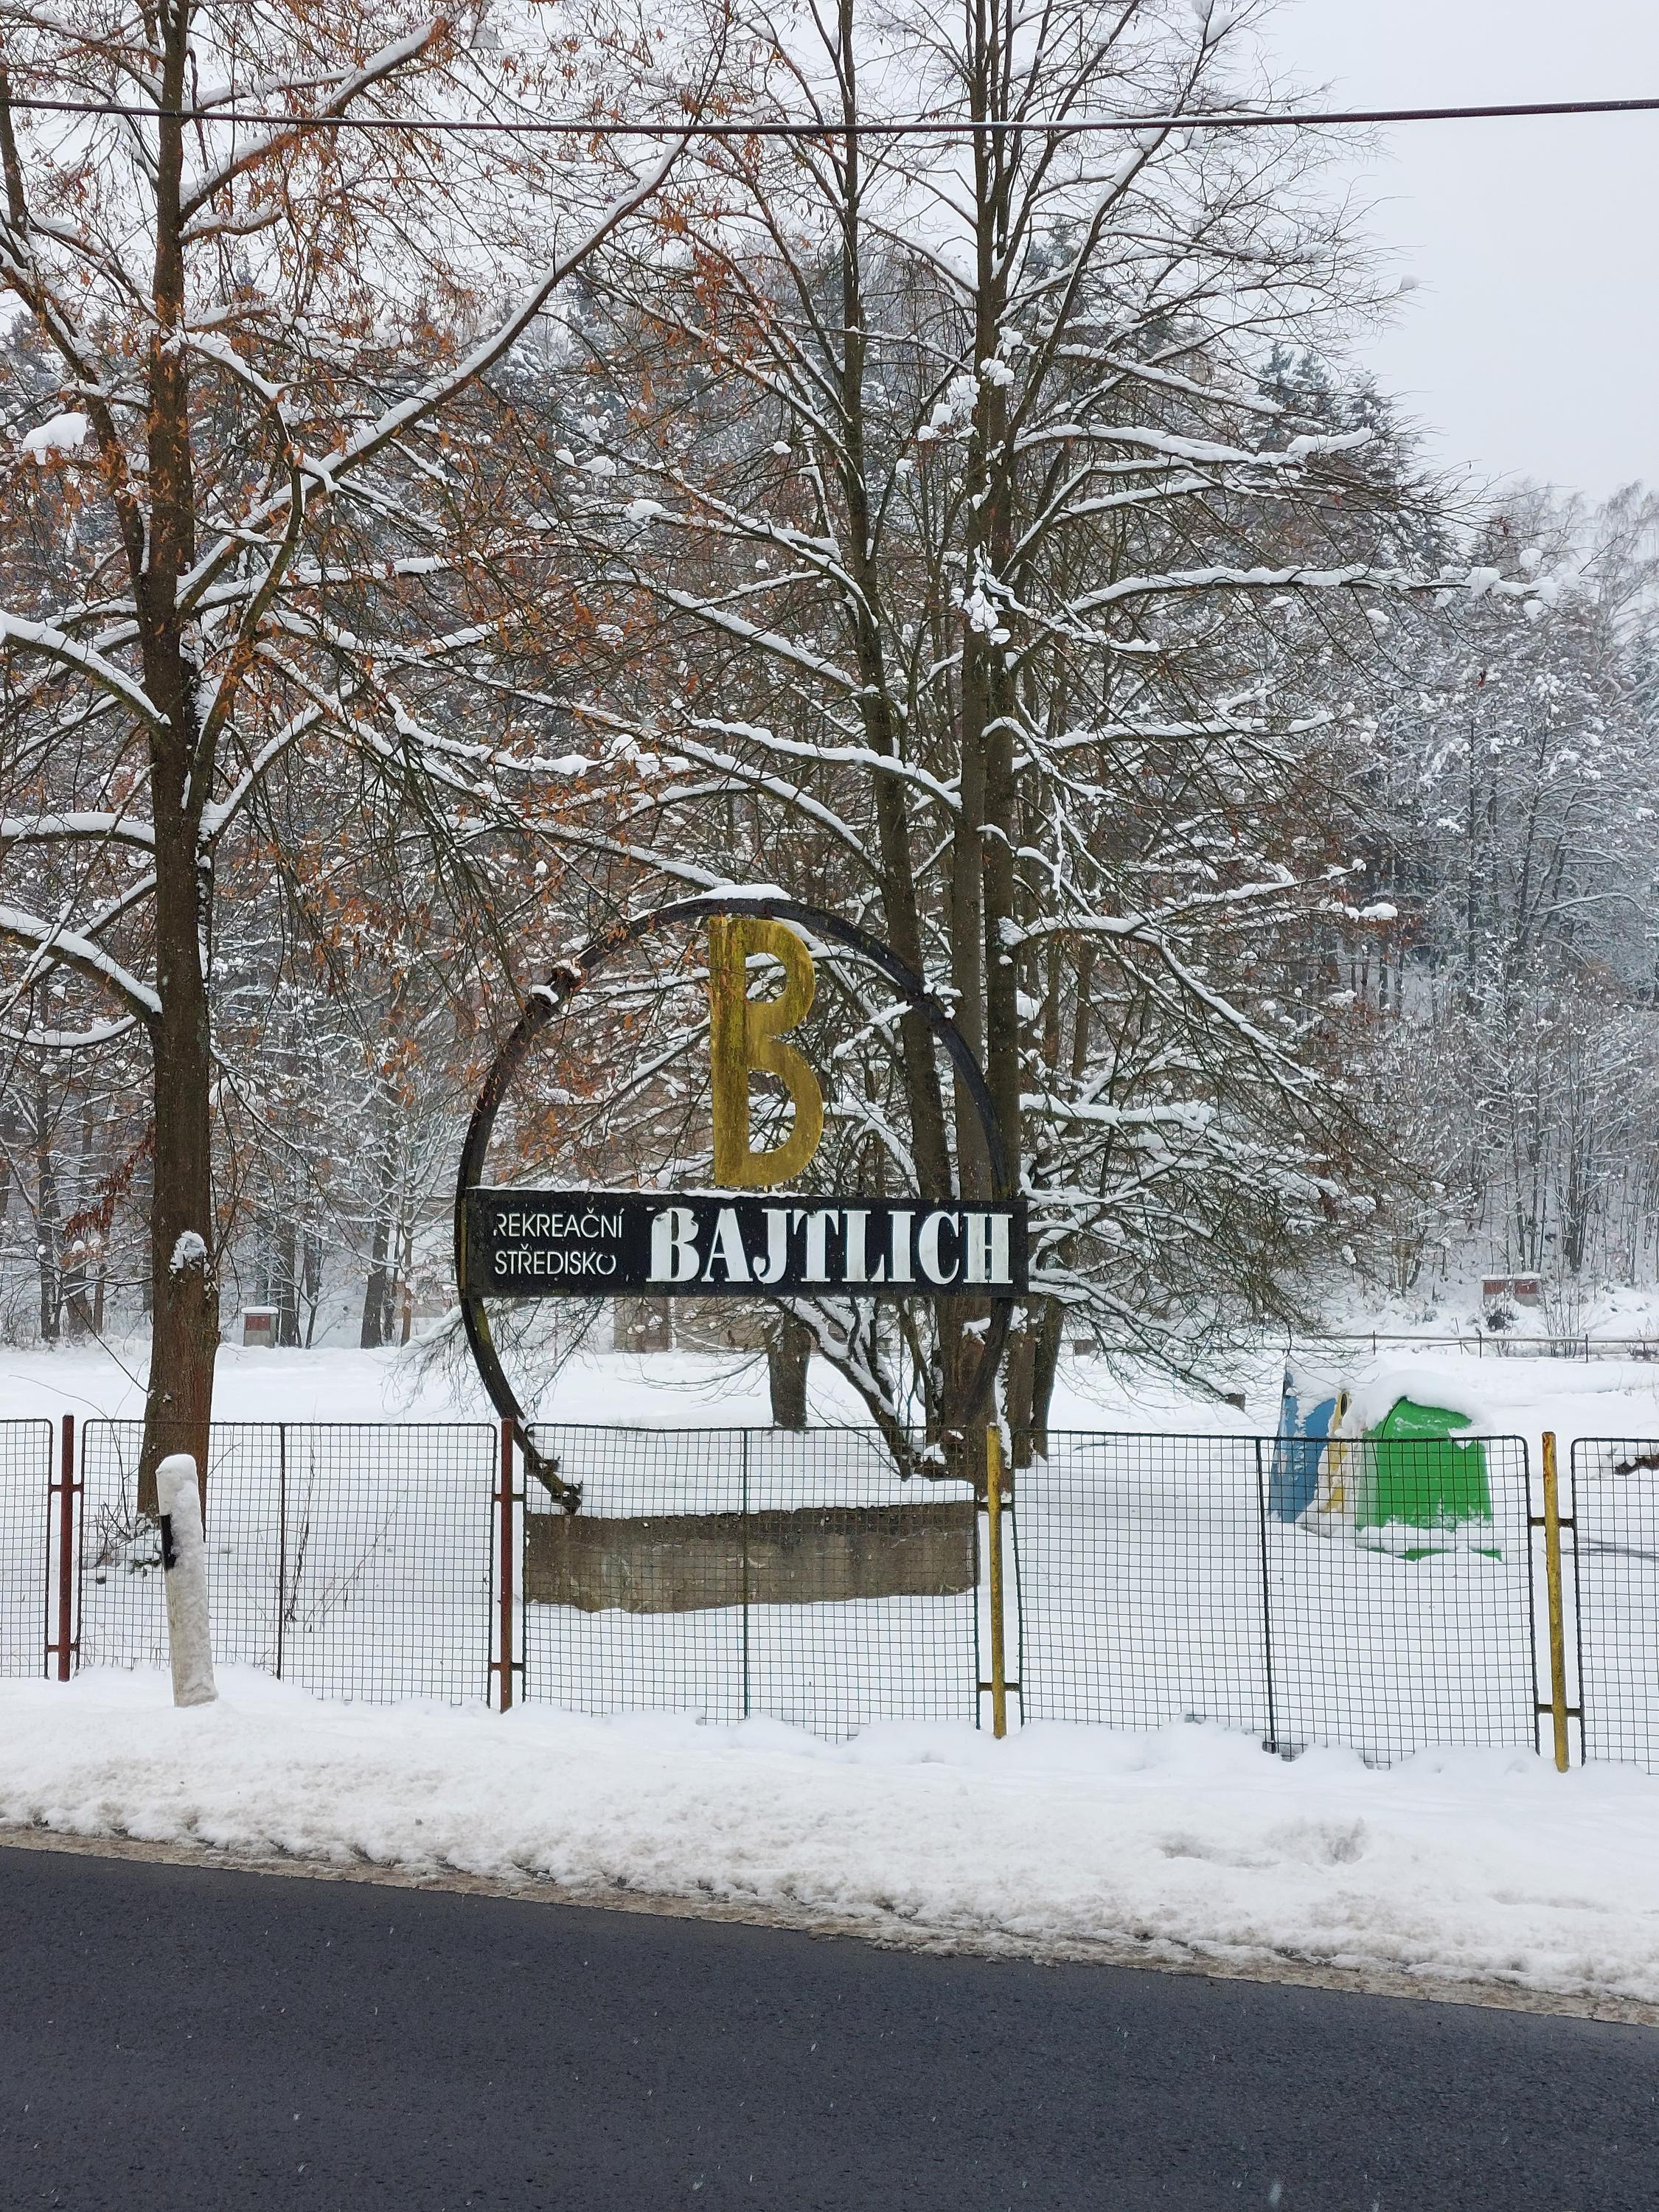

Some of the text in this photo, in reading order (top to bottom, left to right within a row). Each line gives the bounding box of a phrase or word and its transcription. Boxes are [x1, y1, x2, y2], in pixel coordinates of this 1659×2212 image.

[709, 917, 824, 1186] B
[493, 1207, 625, 1238] REKREAČNÍ
[645, 1207, 1014, 1284] BAJTLICH
[494, 1243, 616, 1275] STŘEDISKO
